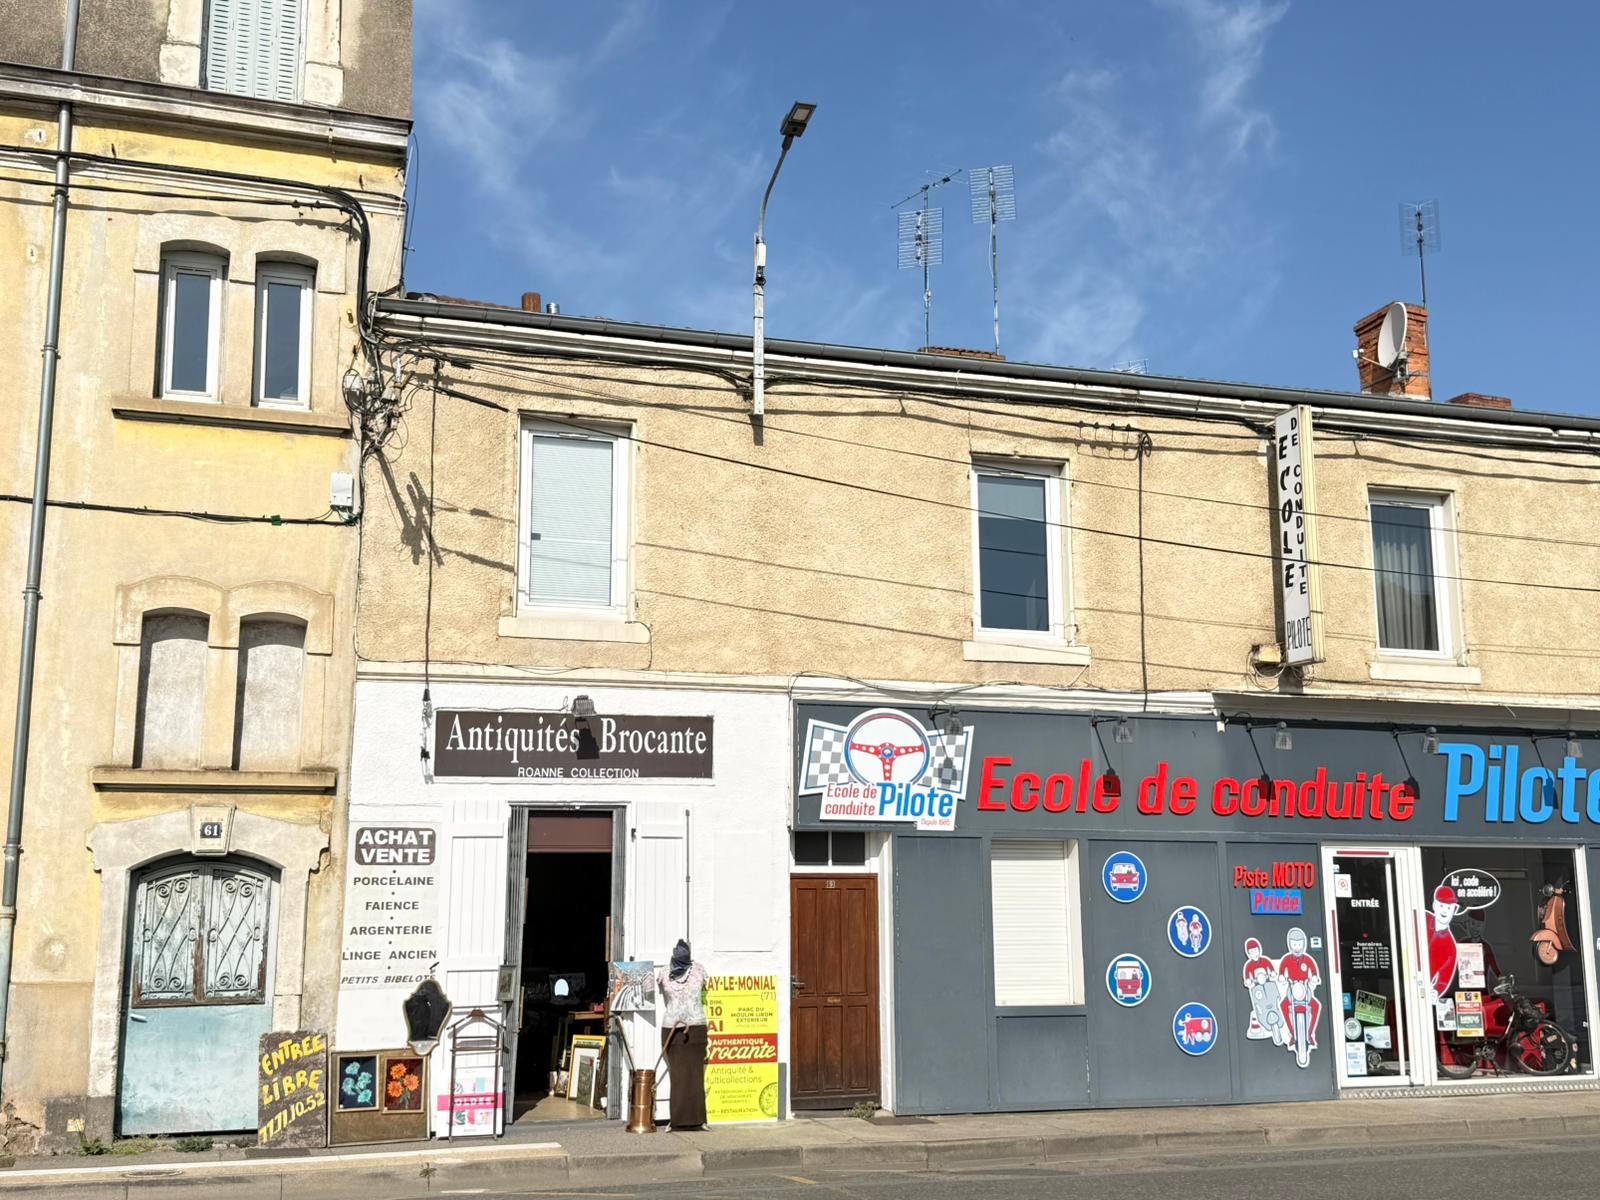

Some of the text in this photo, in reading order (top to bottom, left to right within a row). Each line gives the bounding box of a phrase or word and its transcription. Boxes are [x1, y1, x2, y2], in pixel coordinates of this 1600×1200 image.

[1279, 434, 1295, 589] ECOLE
[1293, 464, 1307, 595] CONDUITE
[1287, 616, 1312, 650] PILOTE
[446, 713, 707, 763] Antiquités Brocante
[517, 767, 640, 778] ROANNE COLLECTION
[826, 783, 877, 799] Ecole de
[977, 756, 1120, 813] Ecole
[1136, 761, 1198, 815] de
[1211, 766, 1415, 820] conduite
[876, 783, 953, 817] Pilote
[824, 801, 876, 816] conduite
[204, 824, 218, 836] 61
[359, 829, 433, 846] ACHAT
[360, 848, 431, 864] VENTE
[353, 876, 434, 886] PORCELAINE
[1233, 861, 1316, 889] Piste MOTO
[365, 901, 420, 911] FAIENCE
[1253, 891, 1299, 913] Privée
[1351, 898, 1380, 908] ENTRÉE
[349, 925, 433, 936] ARGENTERIE
[342, 949, 437, 961] LINGE ANCIEN
[341, 976, 379, 985] PETITS
[760, 991, 777, 1002] (71)
[709, 1006, 723, 1017] 10
[706, 1020, 724, 1032] AI
[712, 1038, 764, 1046] AUTHENTIQUE
[261, 1034, 325, 1076] ENTREE
[711, 1066, 747, 1076] Antiquité
